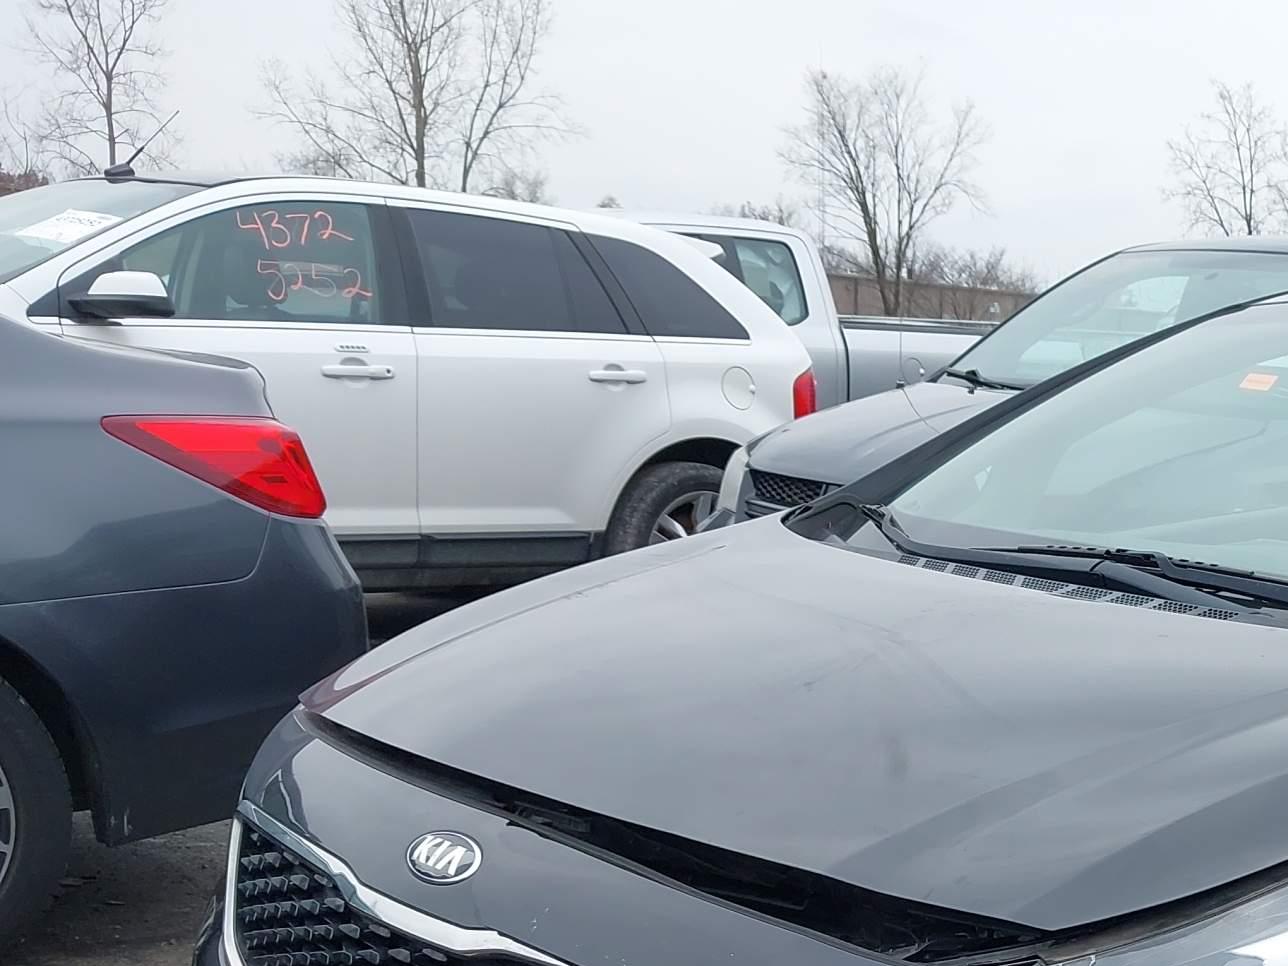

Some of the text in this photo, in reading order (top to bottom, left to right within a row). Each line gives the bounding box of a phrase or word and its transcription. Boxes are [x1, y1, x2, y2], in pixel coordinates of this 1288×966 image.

[235, 209, 356, 251] 4372
[256, 257, 374, 301] 5252
[410, 834, 469, 877] KIA
